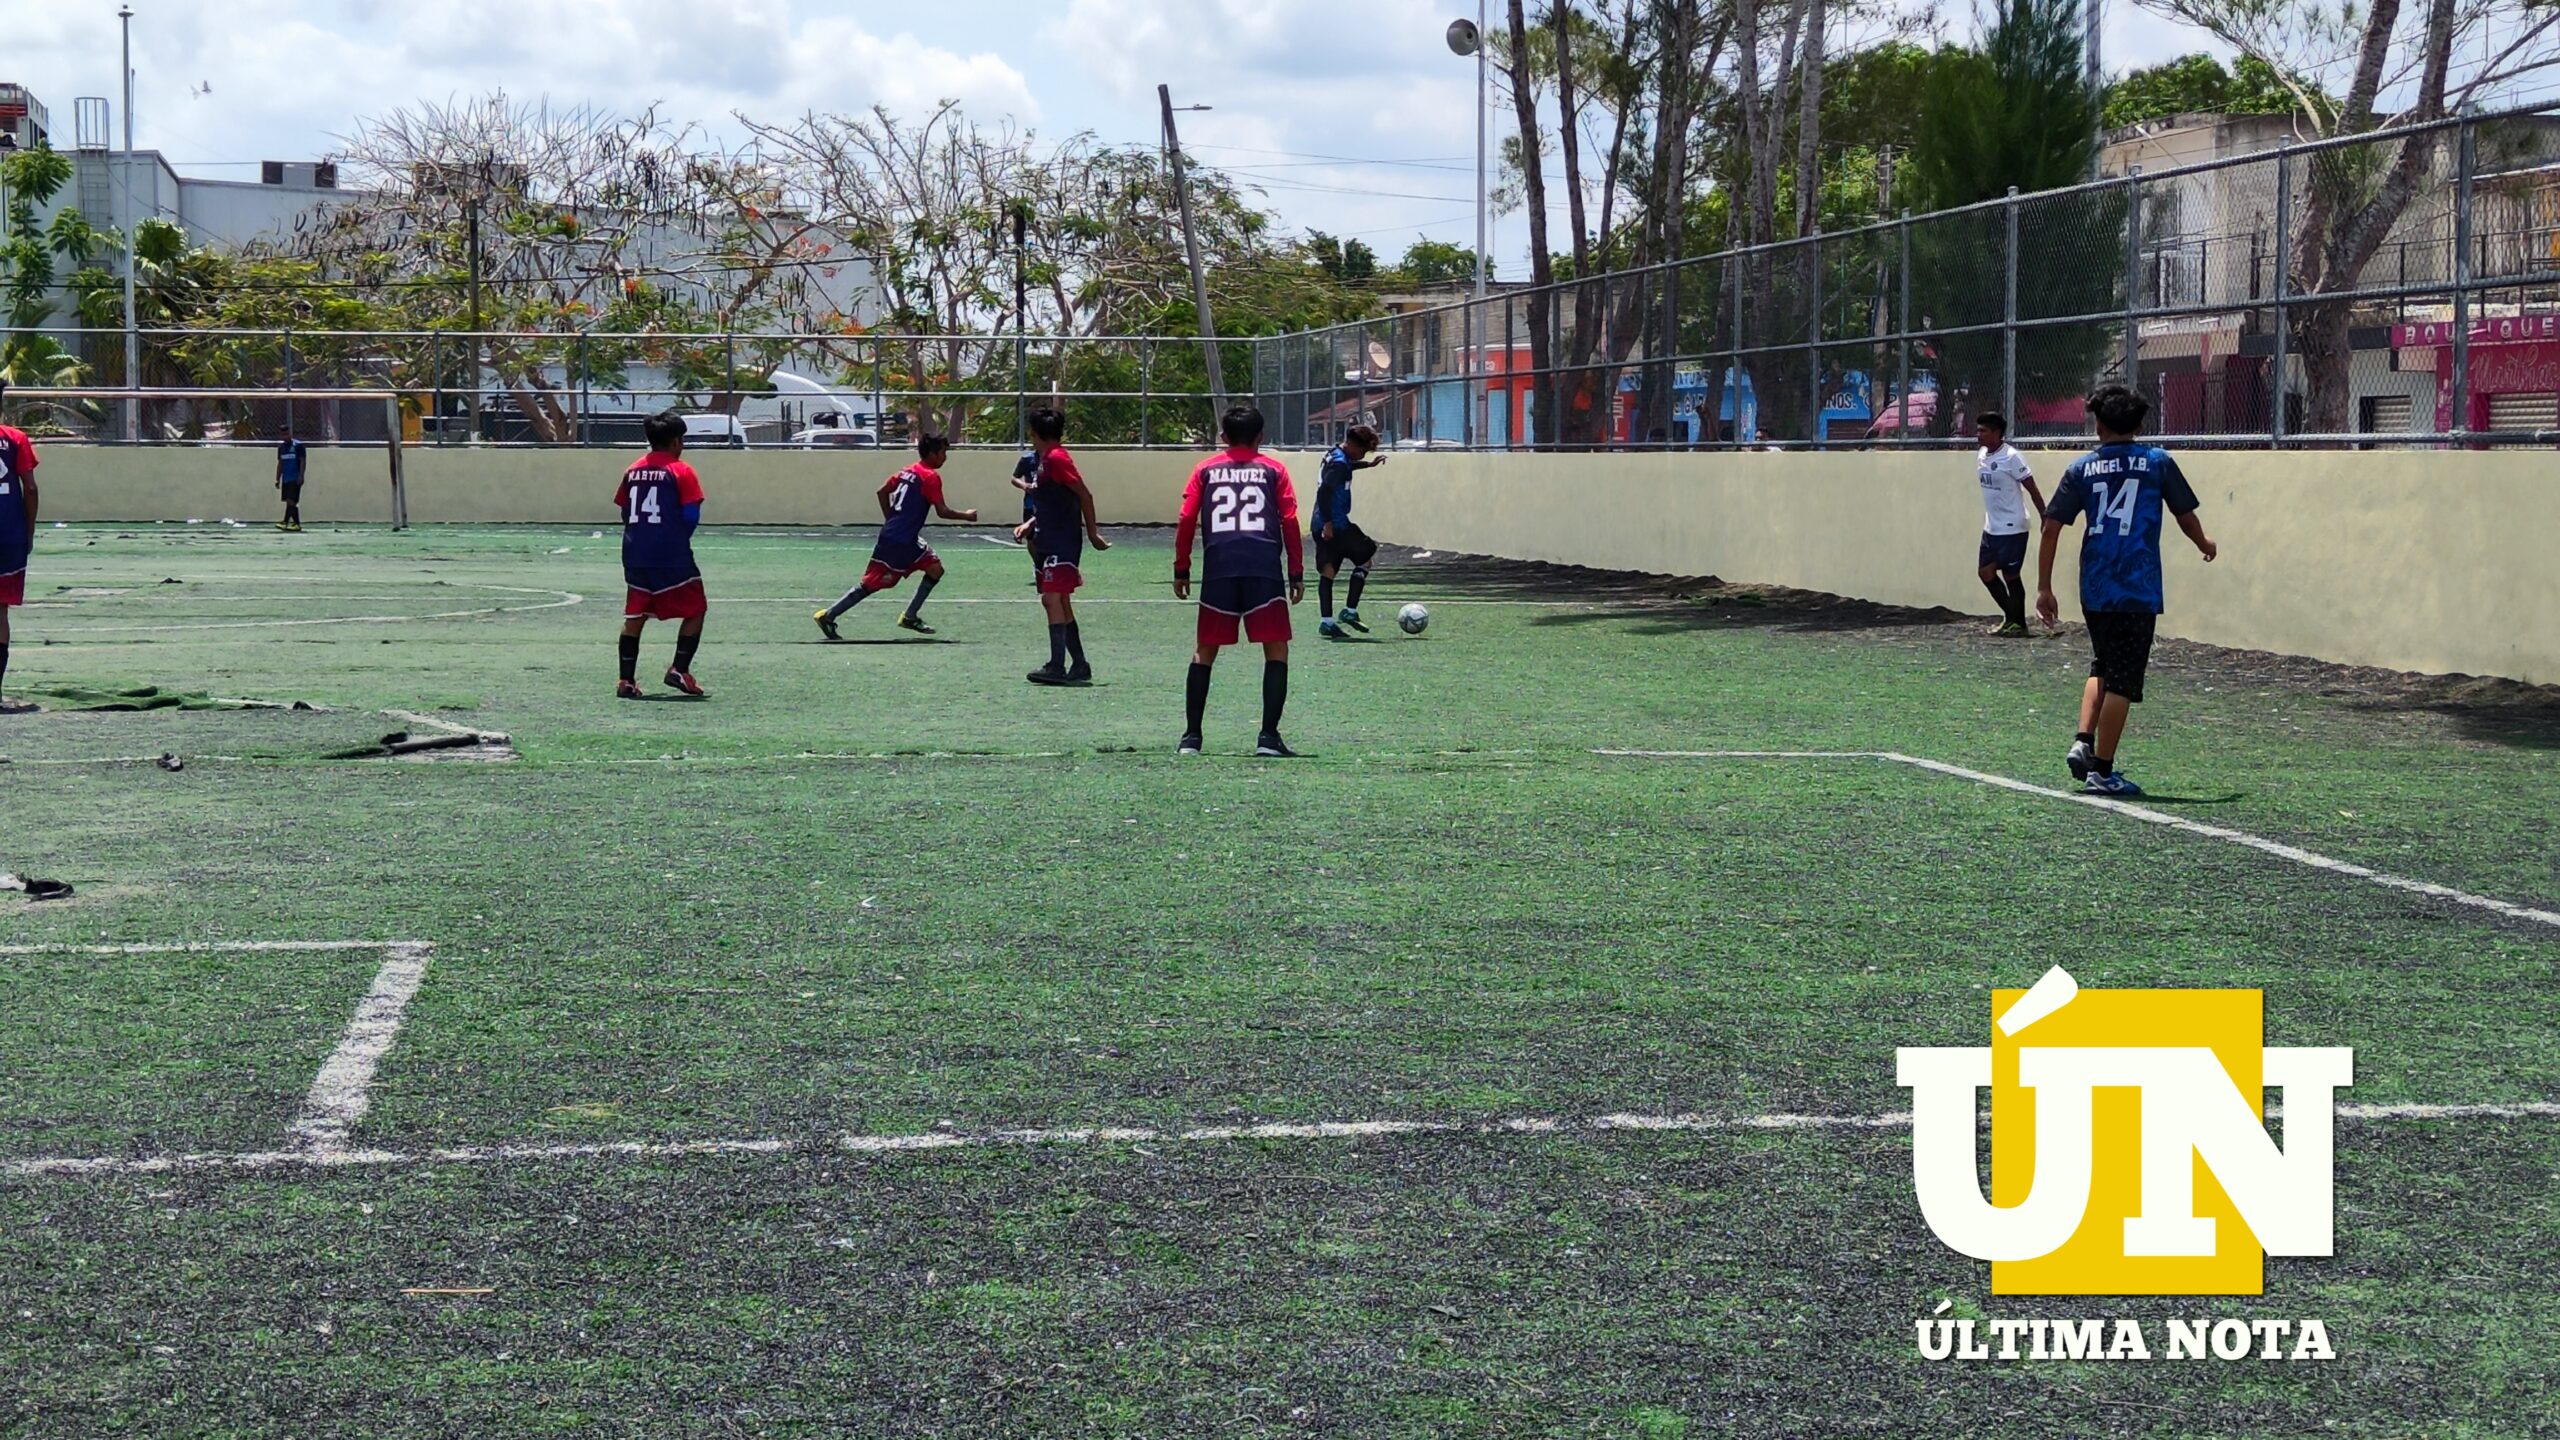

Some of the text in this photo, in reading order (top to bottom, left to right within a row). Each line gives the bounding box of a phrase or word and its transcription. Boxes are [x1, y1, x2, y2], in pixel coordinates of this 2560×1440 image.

[628, 470, 667, 482] MARTIN
[1208, 468, 1267, 484] MANUEL
[2083, 458, 2123, 478] ANGEL
[628, 486, 662, 524] 14
[1211, 486, 1266, 533] 22
[2088, 478, 2140, 536] 14
